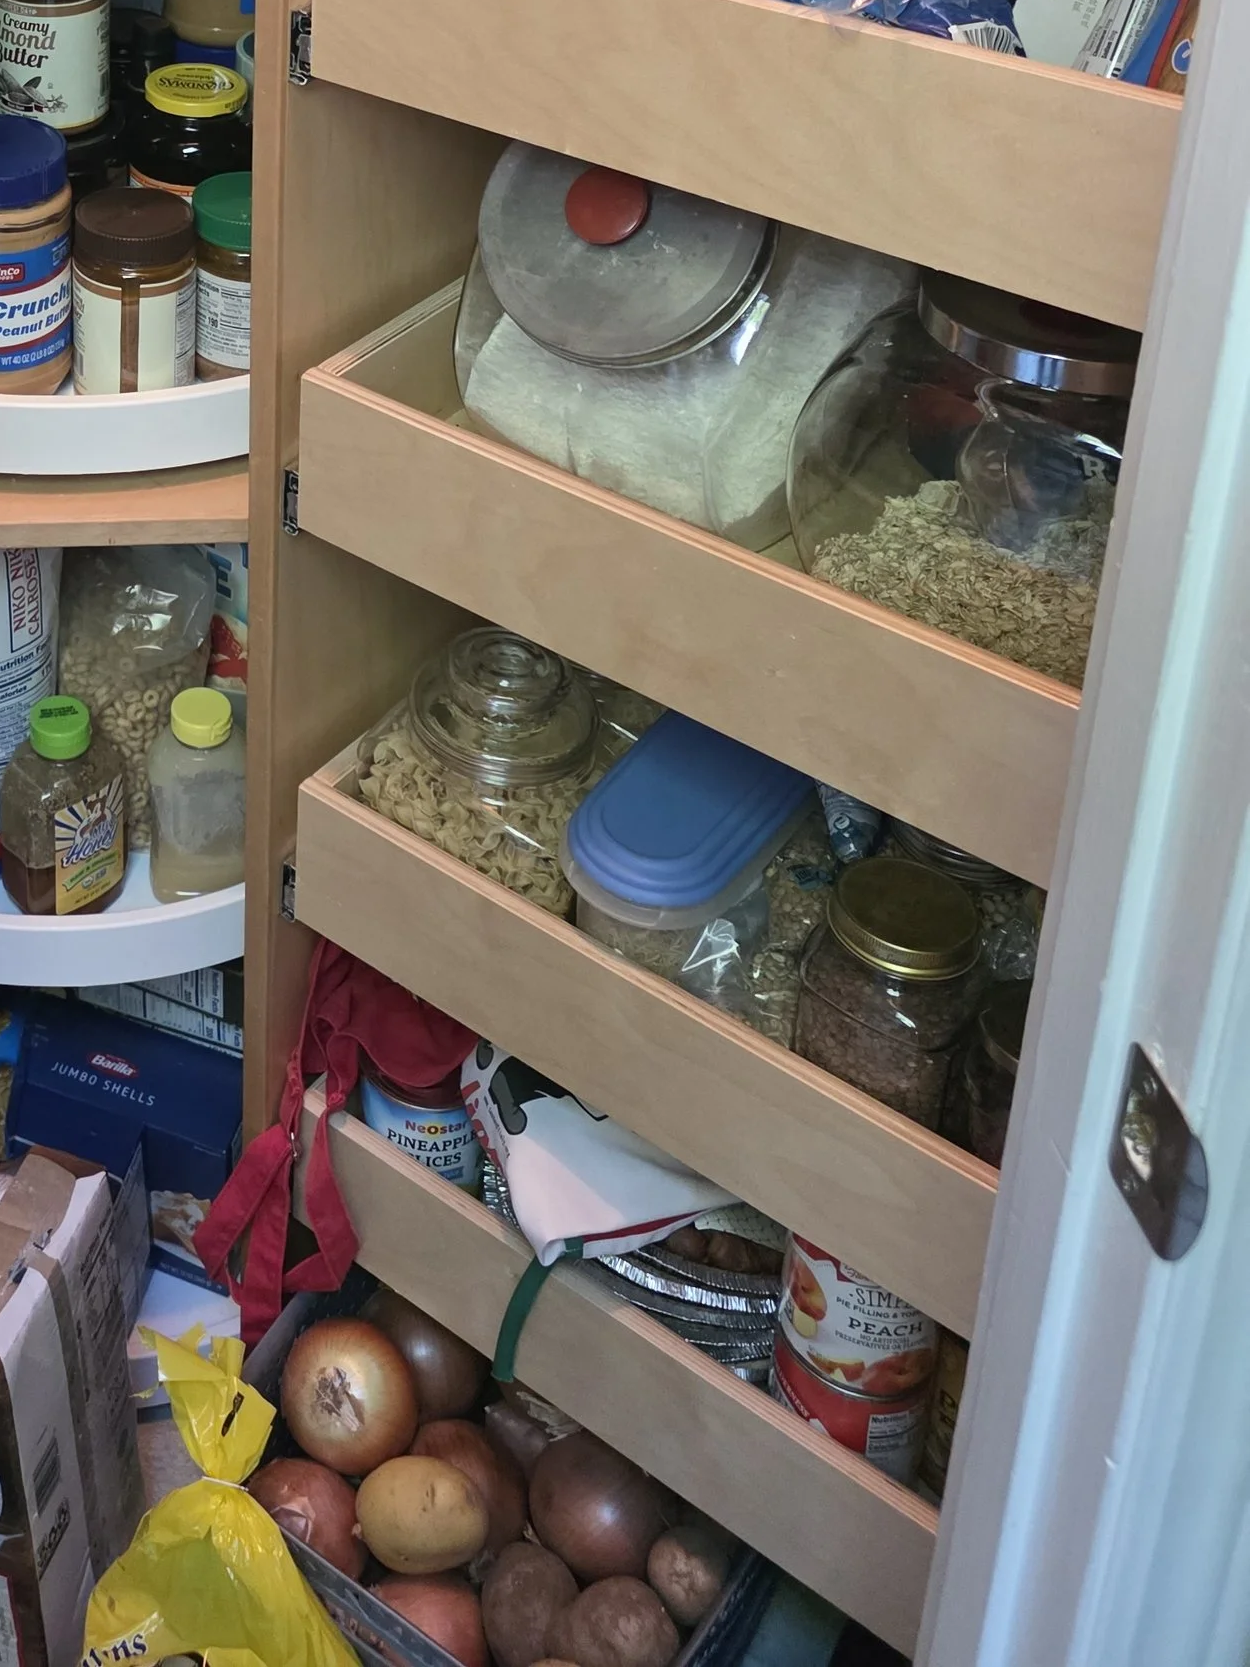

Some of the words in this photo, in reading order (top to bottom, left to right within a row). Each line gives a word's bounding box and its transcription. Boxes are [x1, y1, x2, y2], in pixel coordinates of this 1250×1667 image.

[3, 12, 50, 36] Creamy
[23, 553, 40, 636] CALROSE
[12, 585, 26, 633] NIKO
[91, 1053, 135, 1078] Barilla
[51, 1061, 97, 1086] JUMBO
[103, 1079, 156, 1108] SHELLS
[405, 1119, 467, 1135] Neostar
[387, 1128, 476, 1153] PINEAPPLE
[836, 1295, 851, 1309] PIE
[852, 1304, 891, 1320] FILLING
[892, 1312, 898, 1320] &
[848, 1316, 922, 1337] PEACH
[873, 1336, 910, 1344] ARTIFICIAL
